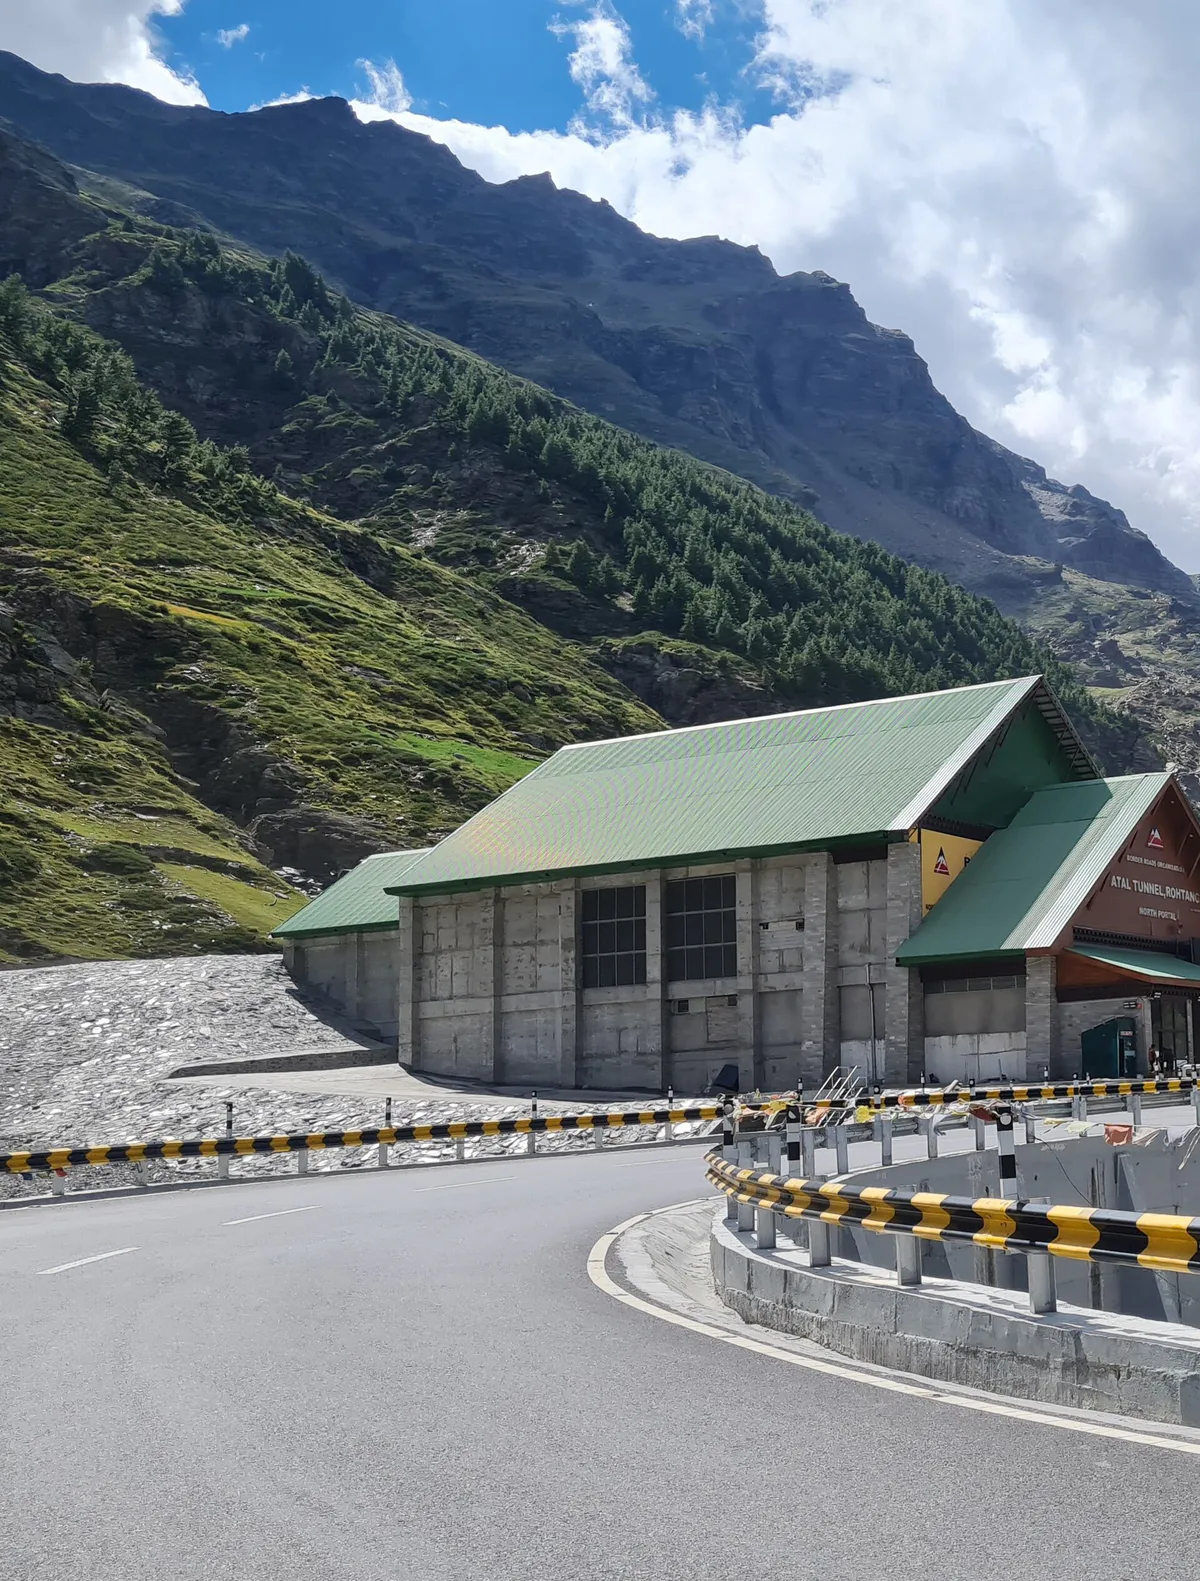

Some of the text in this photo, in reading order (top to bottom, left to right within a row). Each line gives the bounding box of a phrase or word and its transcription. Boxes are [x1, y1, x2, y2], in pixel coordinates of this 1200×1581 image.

[1111, 875, 1131, 890] ATAL
[1139, 907, 1177, 921] NORTH PORTAL
